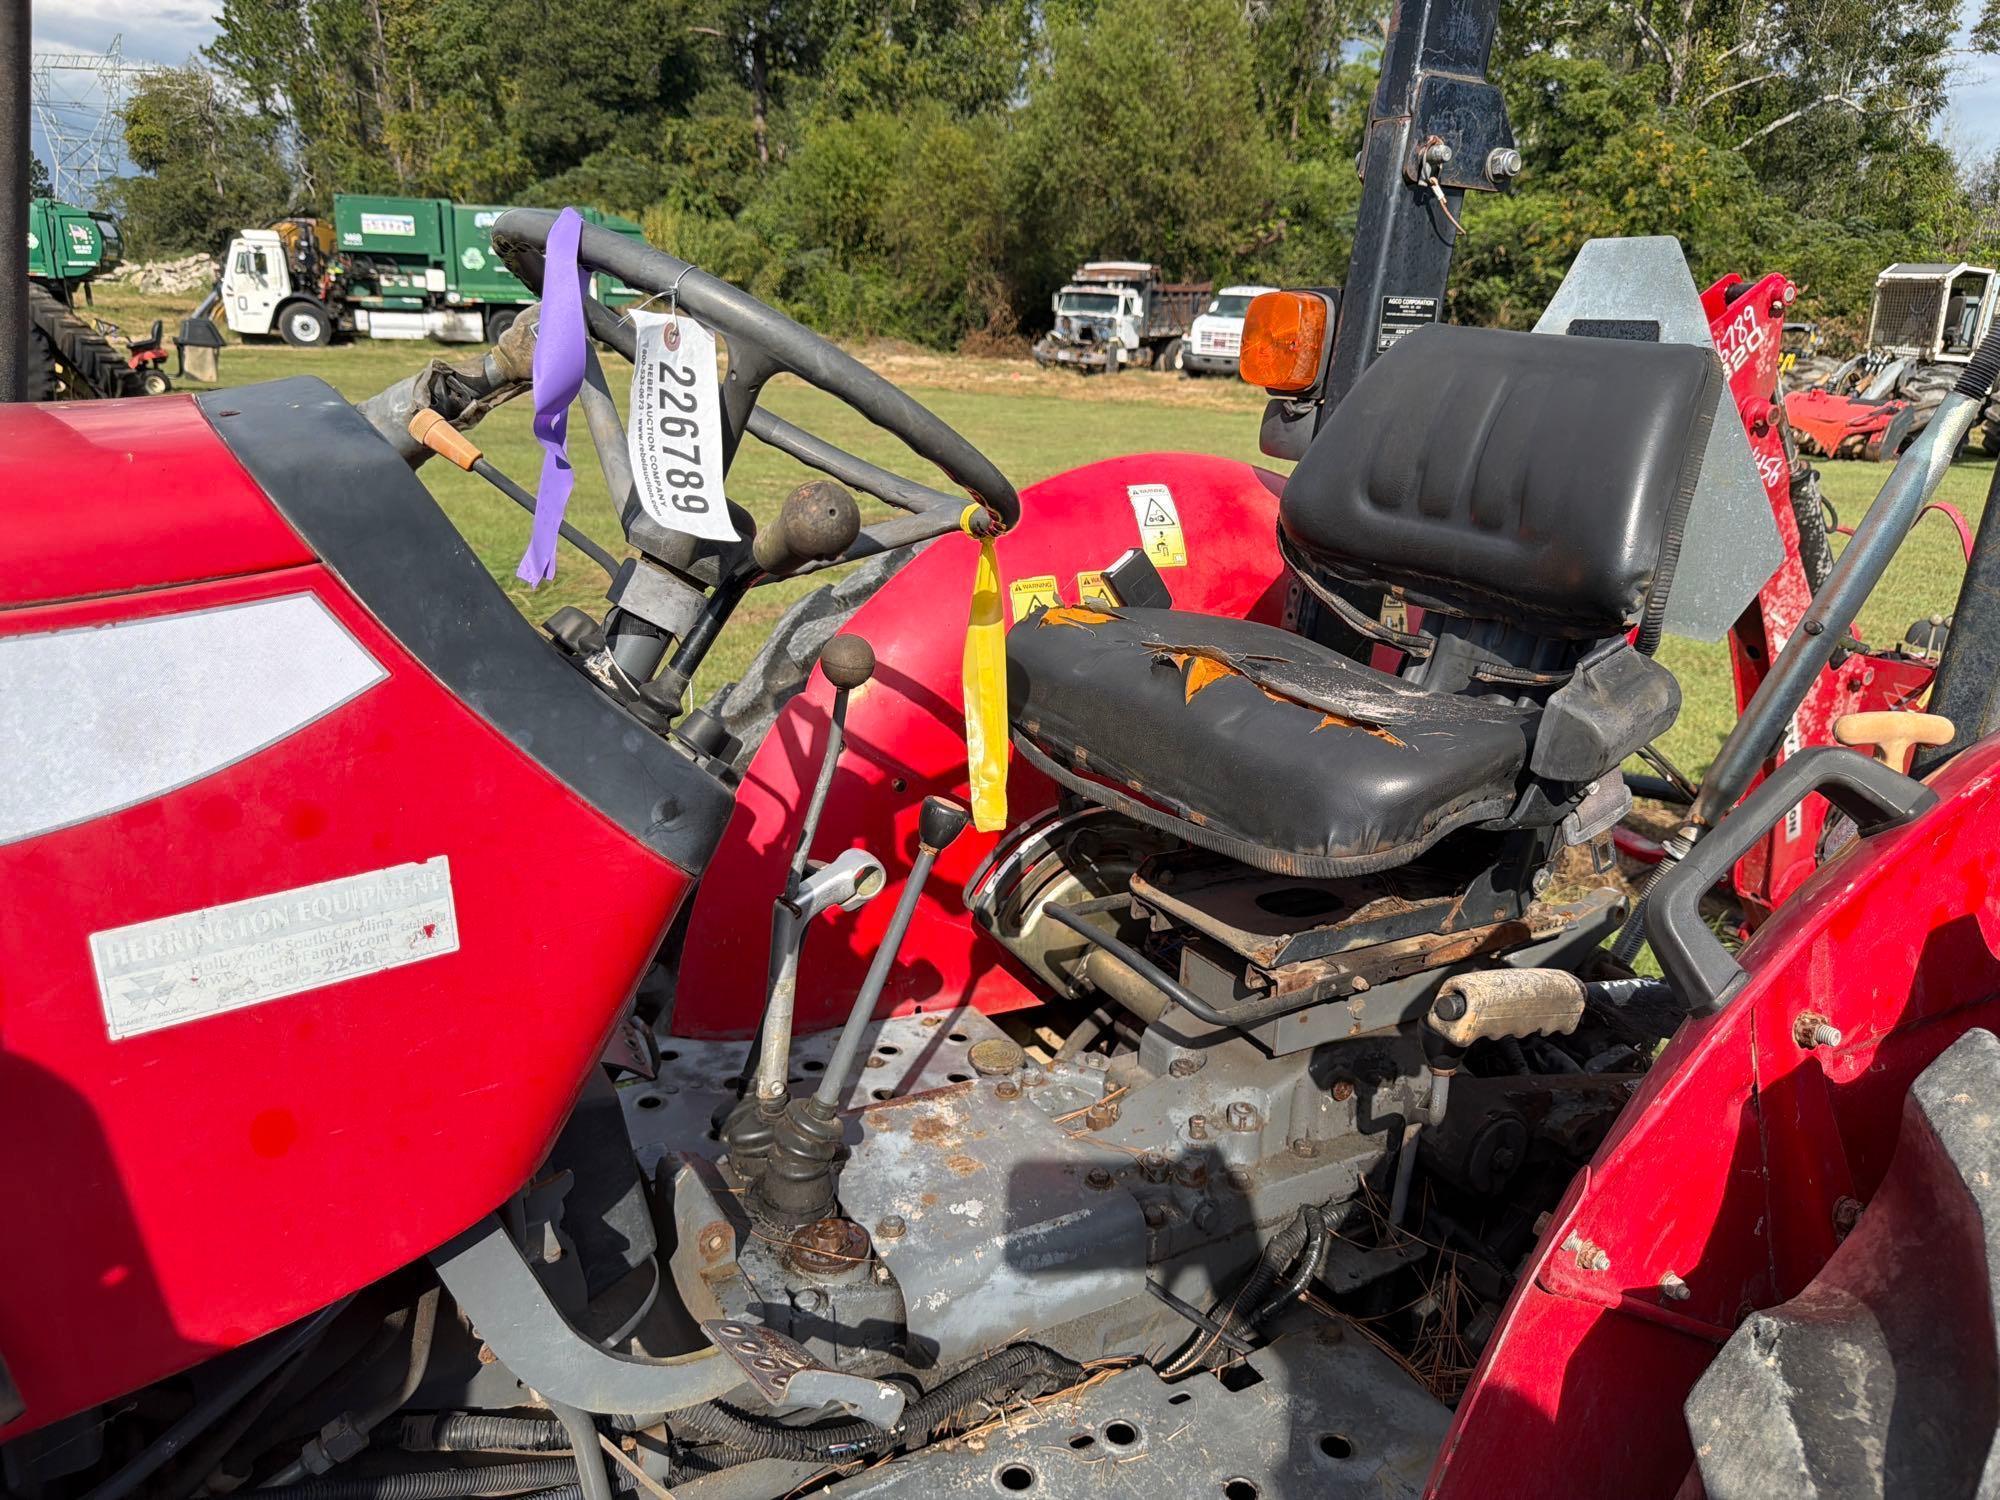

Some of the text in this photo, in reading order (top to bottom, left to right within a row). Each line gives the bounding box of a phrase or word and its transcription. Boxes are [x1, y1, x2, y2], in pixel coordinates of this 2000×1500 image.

[1716, 305, 1756, 363] 6789
[638, 418, 663, 517] www.rebelauction.com
[646, 363, 667, 508] REBEL AUCTION COMPANY
[659, 361, 710, 514] 226789
[1022, 582, 1053, 590] WARNING
[105, 905, 292, 967] HERRINGTON
